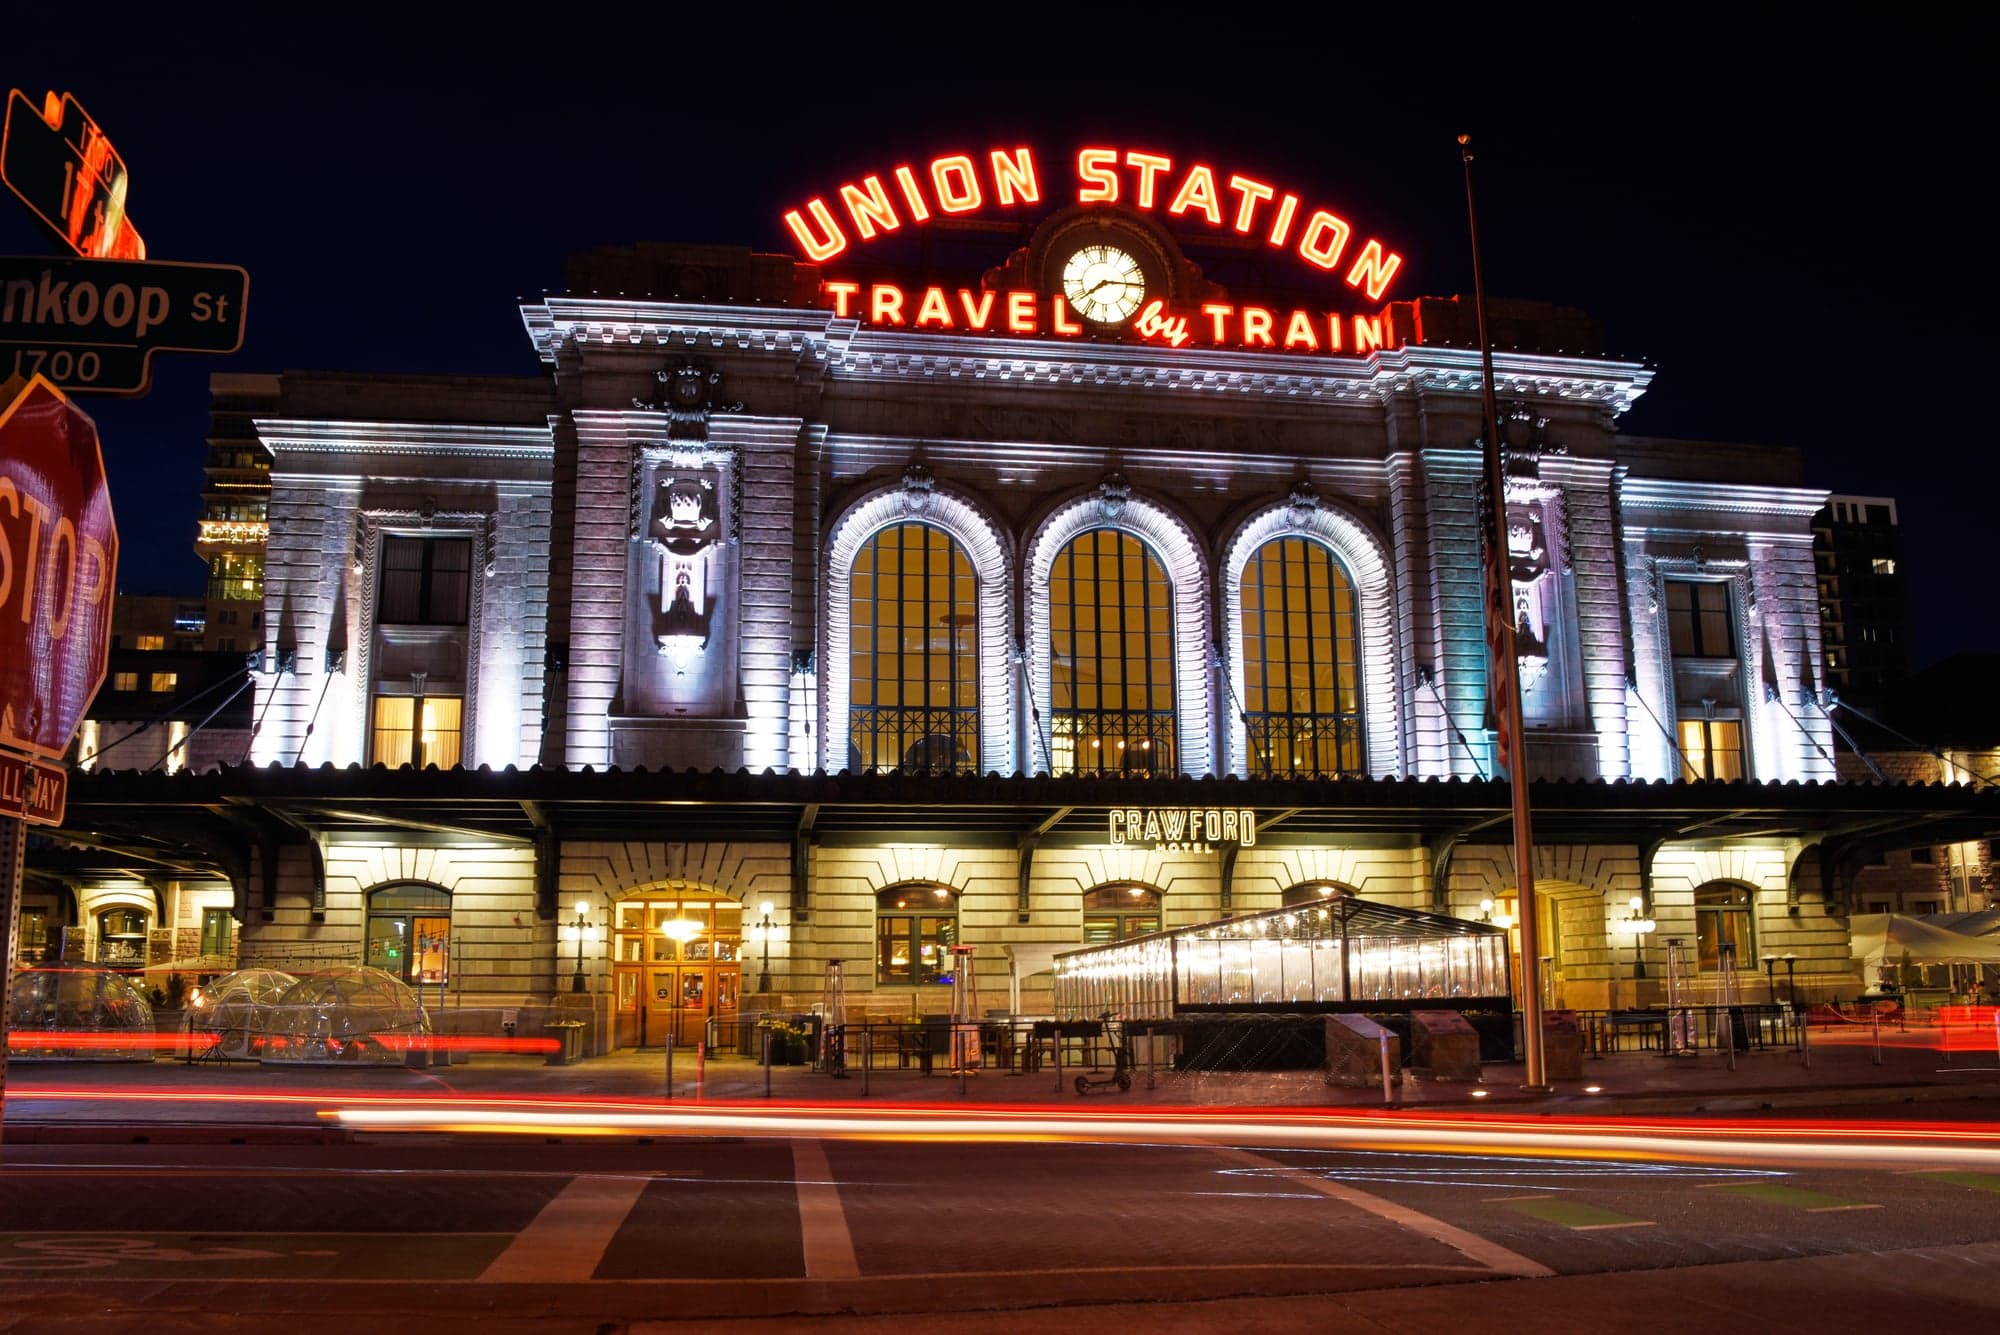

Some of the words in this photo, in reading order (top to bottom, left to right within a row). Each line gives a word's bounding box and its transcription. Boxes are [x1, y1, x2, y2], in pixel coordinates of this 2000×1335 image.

[784, 147, 1040, 262] UNION
[1078, 147, 1402, 302] STATION
[0, 268, 170, 338] nkoop
[190, 292, 229, 322] St
[824, 282, 1082, 334] TRAVEL
[1134, 300, 1189, 347] by
[1203, 304, 1382, 353] TRAIN
[14, 350, 101, 381] 1700
[0, 476, 107, 640] STOP
[1109, 810, 1255, 847] CRAWFORD
[1155, 842, 1213, 854] HOTEL
